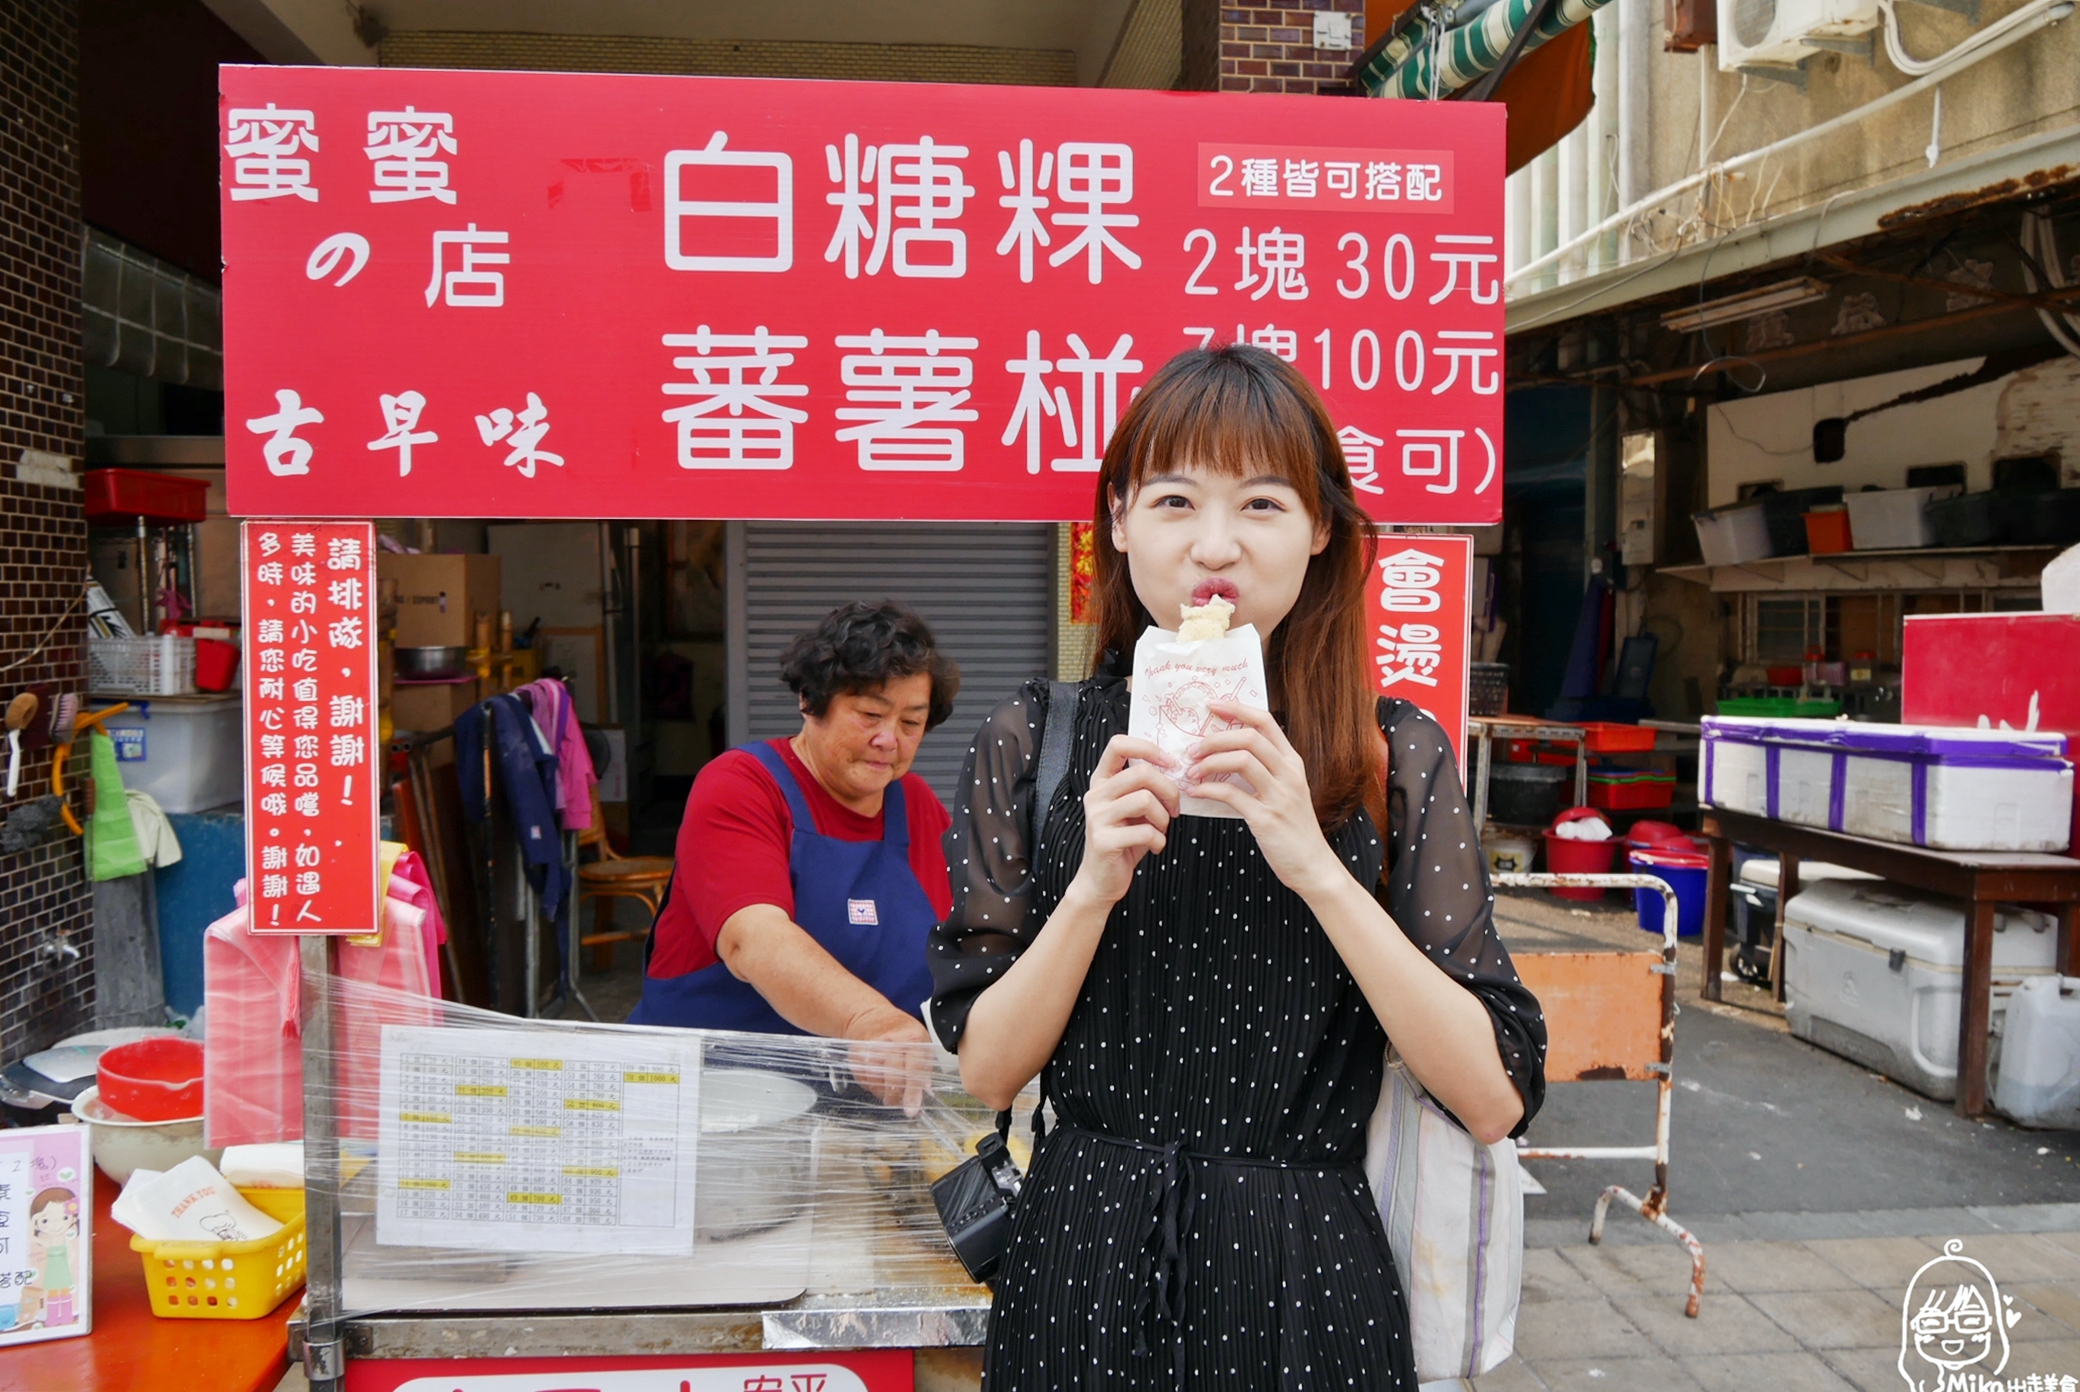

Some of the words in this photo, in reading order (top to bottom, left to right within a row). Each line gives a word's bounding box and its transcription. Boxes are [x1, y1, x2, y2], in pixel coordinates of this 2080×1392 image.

[224, 103, 458, 205] 蜜蜜
[1209, 155, 1442, 202] 2種皆可搭配
[663, 129, 1143, 285] 白糖粿
[306, 223, 510, 308] の店
[246, 389, 564, 479] 古早味
[1375, 548, 1445, 721] 會燙
[171, 1193, 199, 1219] THANK
[196, 1186, 216, 1199] YOU
